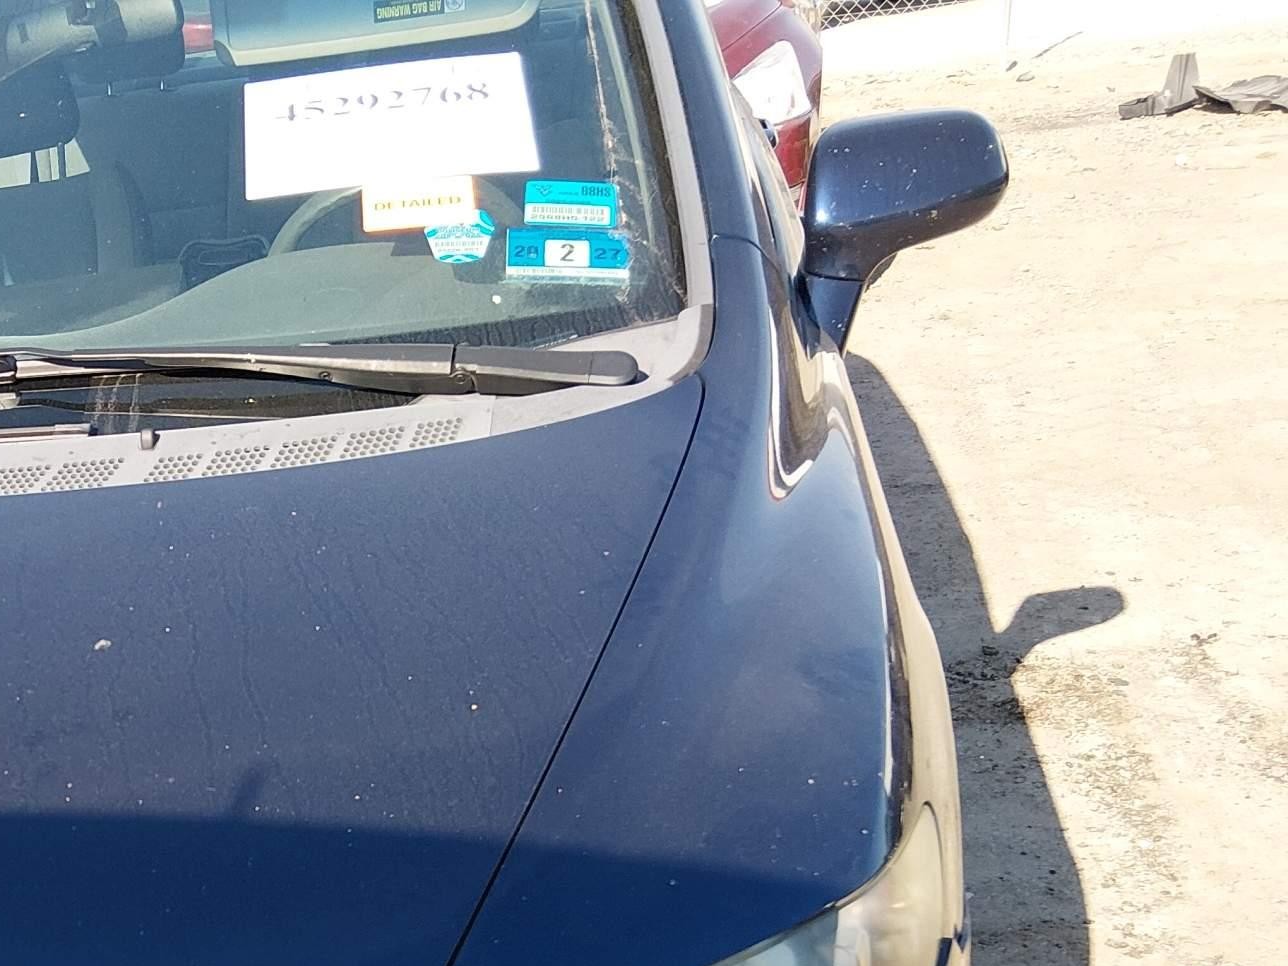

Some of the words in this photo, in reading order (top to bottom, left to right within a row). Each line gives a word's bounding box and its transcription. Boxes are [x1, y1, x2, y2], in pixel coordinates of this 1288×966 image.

[376, 4, 411, 19] WARNING
[412, 2, 428, 14] BAG
[428, 0, 442, 11] AIR
[275, 82, 490, 122] 45292768
[373, 195, 462, 211] DETAILED
[559, 243, 576, 262] 2
